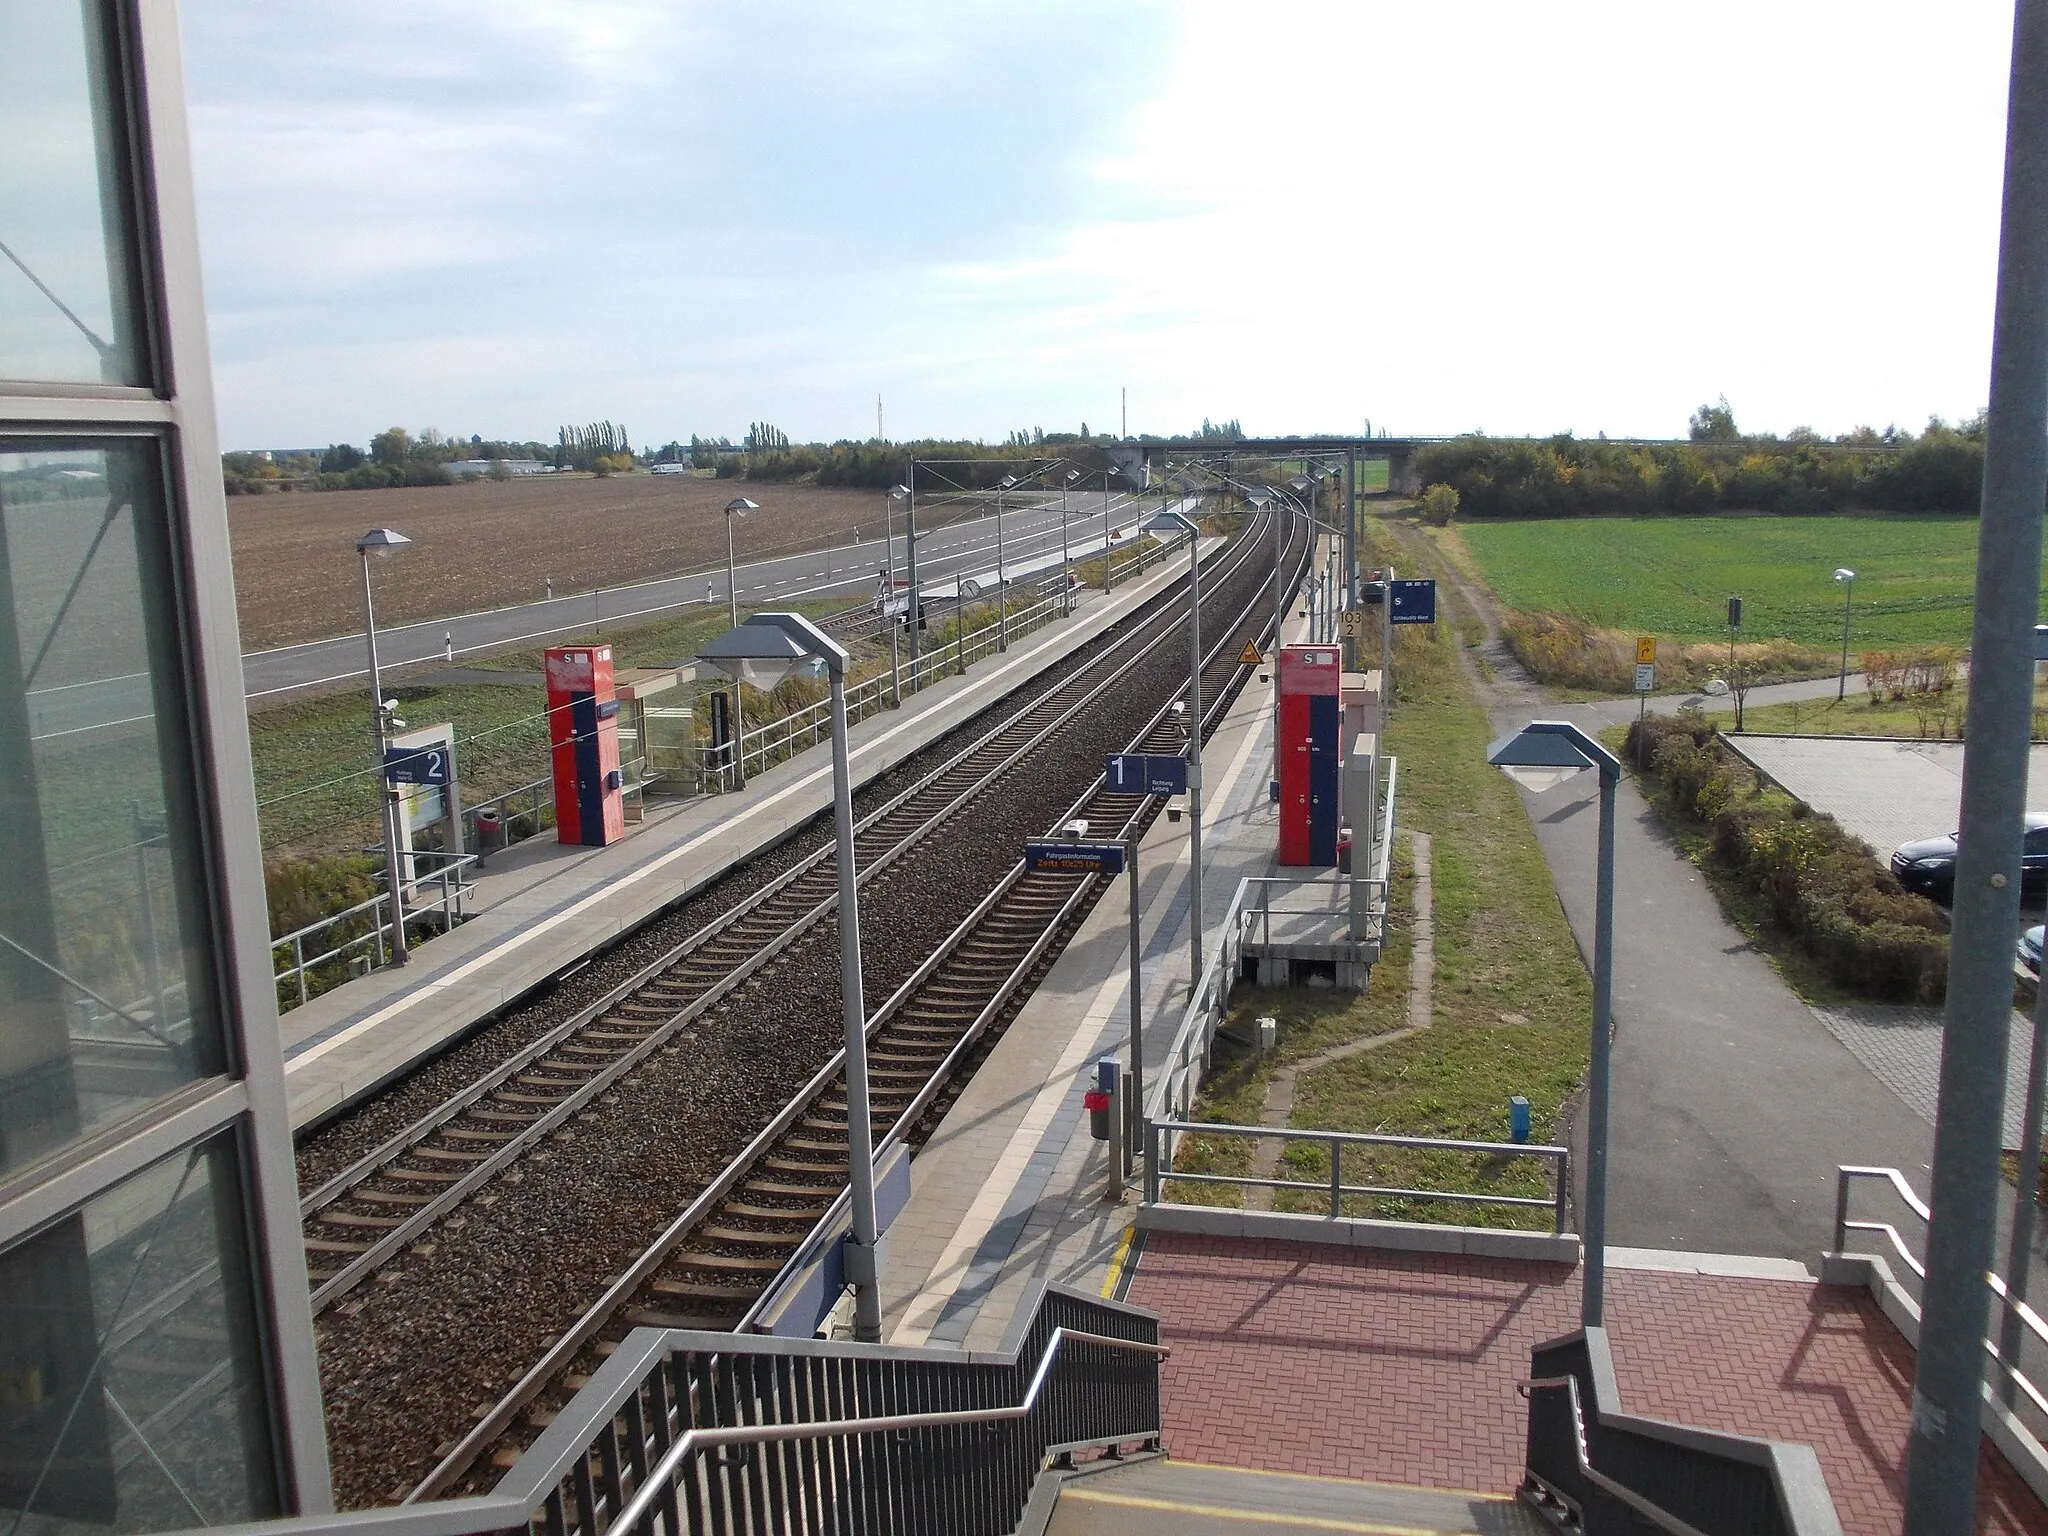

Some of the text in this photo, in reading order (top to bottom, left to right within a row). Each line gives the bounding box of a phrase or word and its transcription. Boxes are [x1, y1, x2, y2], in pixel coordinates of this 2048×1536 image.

[1394, 597, 1402, 606] S
[1340, 612, 1362, 624] 103
[1346, 624, 1354, 635] 2
[564, 653, 572, 663] S
[597, 651, 603, 662] S
[1304, 653, 1313, 664] S
[427, 751, 443, 777] 2
[1111, 756, 1123, 784] 1
[1045, 851, 1101, 860] Fahrgastinformation
